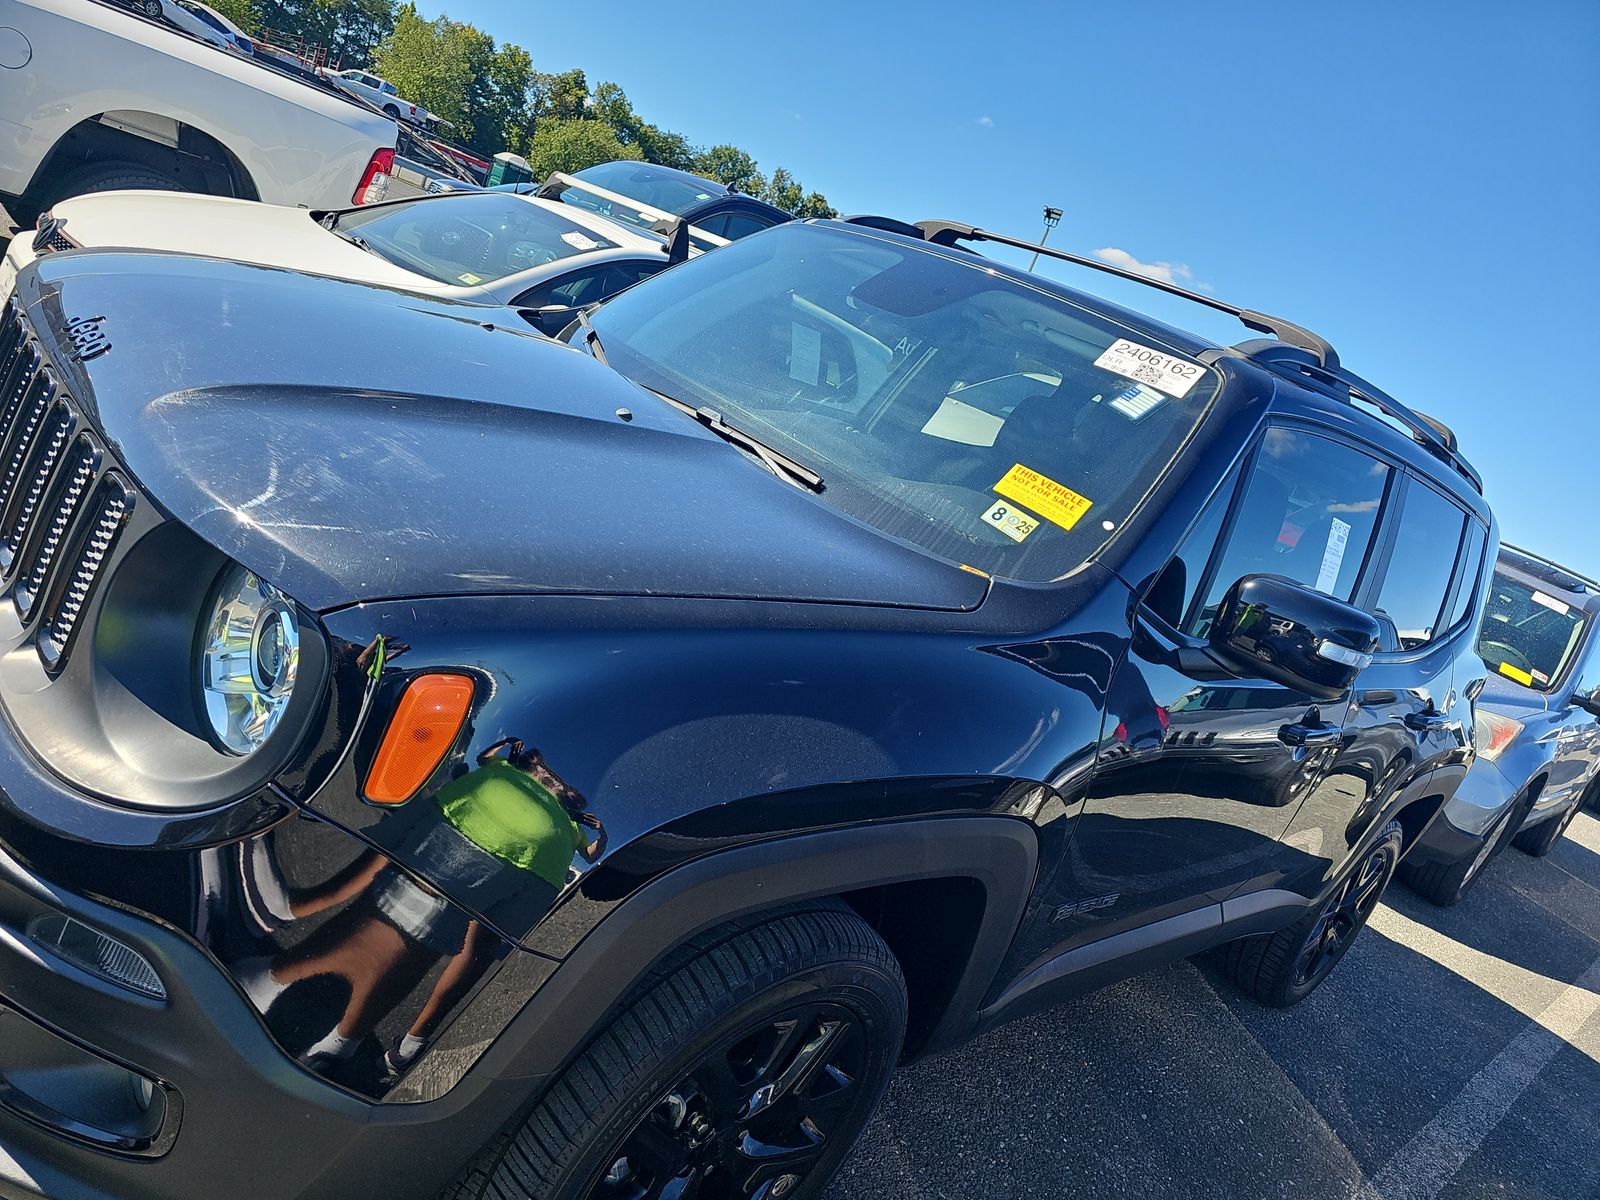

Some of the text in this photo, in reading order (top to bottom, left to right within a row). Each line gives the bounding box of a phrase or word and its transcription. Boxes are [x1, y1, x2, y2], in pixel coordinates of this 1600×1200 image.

[62, 316, 113, 362] Jeep
[1114, 343, 1197, 380] 2406162
[1010, 474, 1077, 511] NOT FOR SALE
[1015, 466, 1040, 482] THIS
[1040, 479, 1086, 508] VEHICLE
[991, 507, 1008, 521] 8
[1015, 520, 1034, 535] 25
